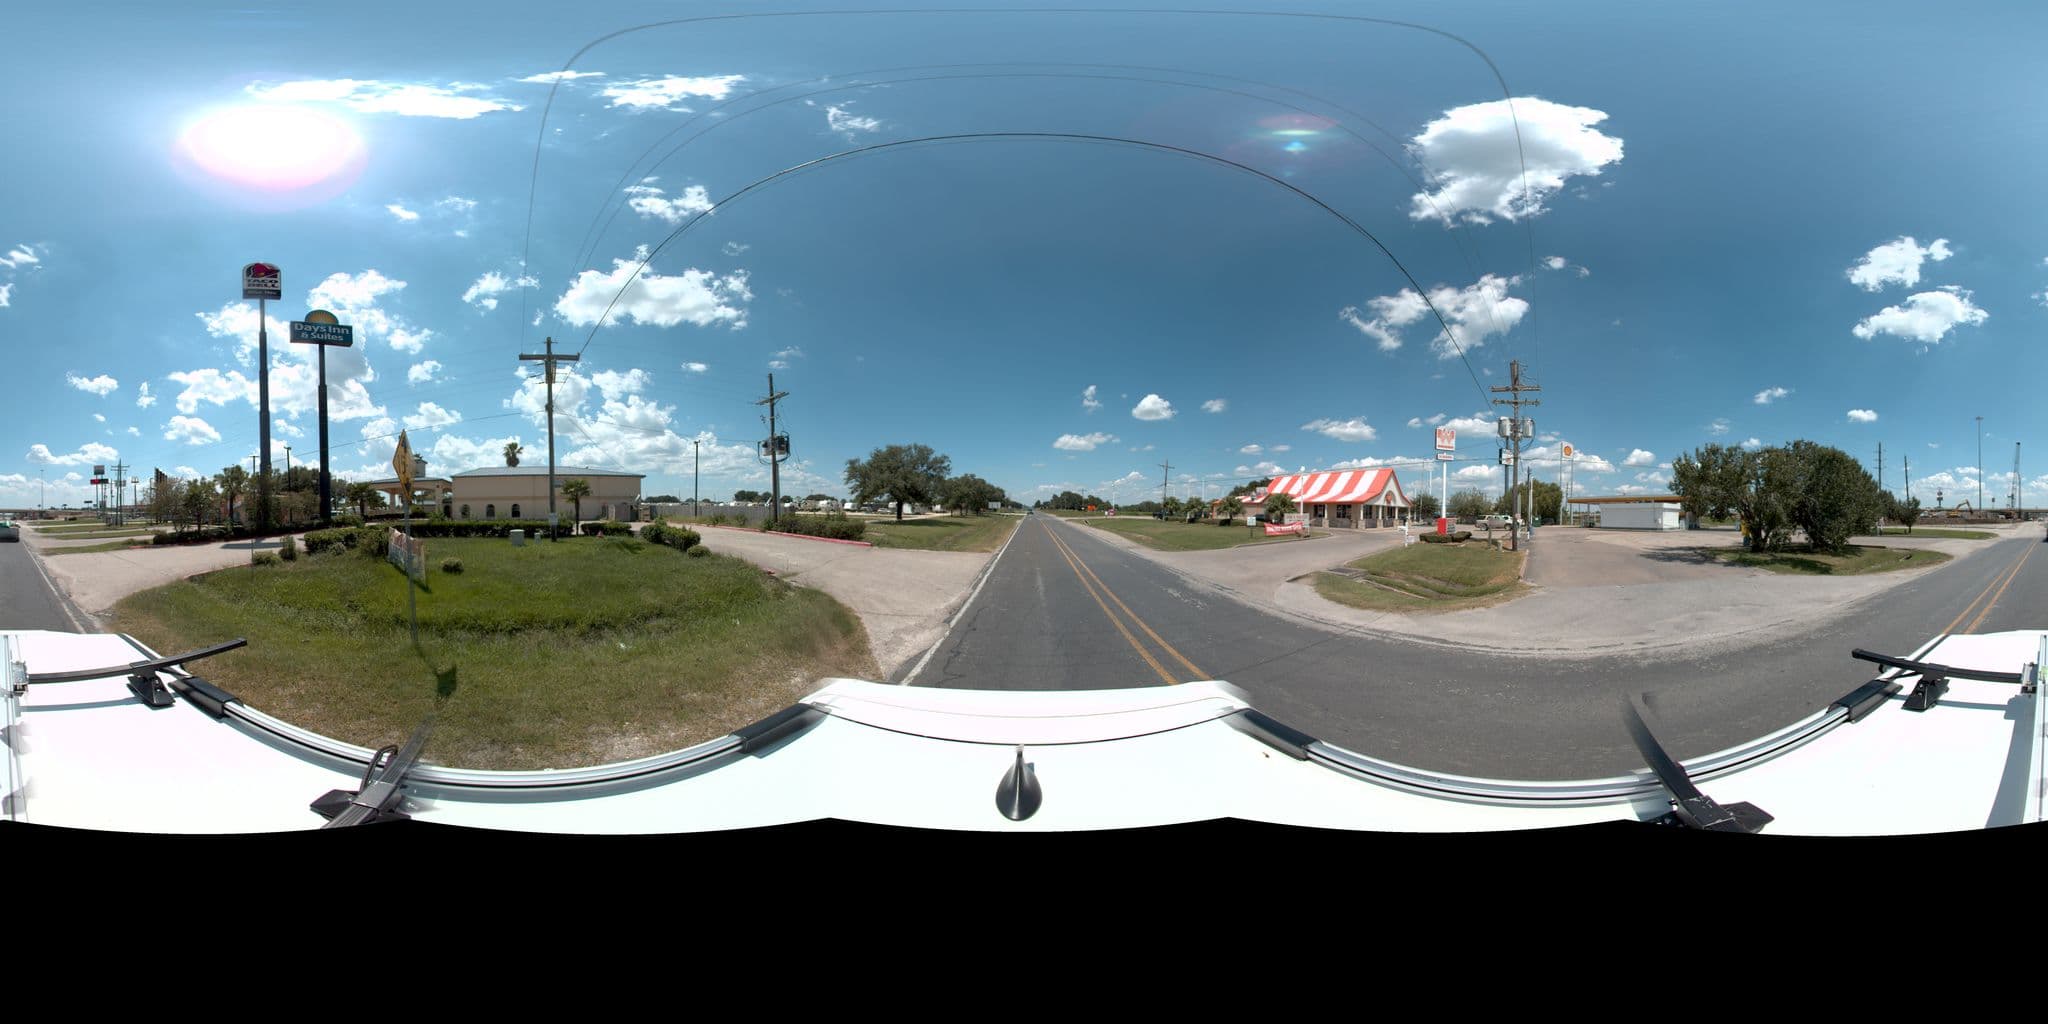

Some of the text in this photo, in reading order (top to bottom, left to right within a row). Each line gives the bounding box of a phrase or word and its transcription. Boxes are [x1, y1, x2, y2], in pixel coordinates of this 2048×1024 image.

[294, 322, 350, 334] Days Inn
[310, 332, 344, 341] Suites
